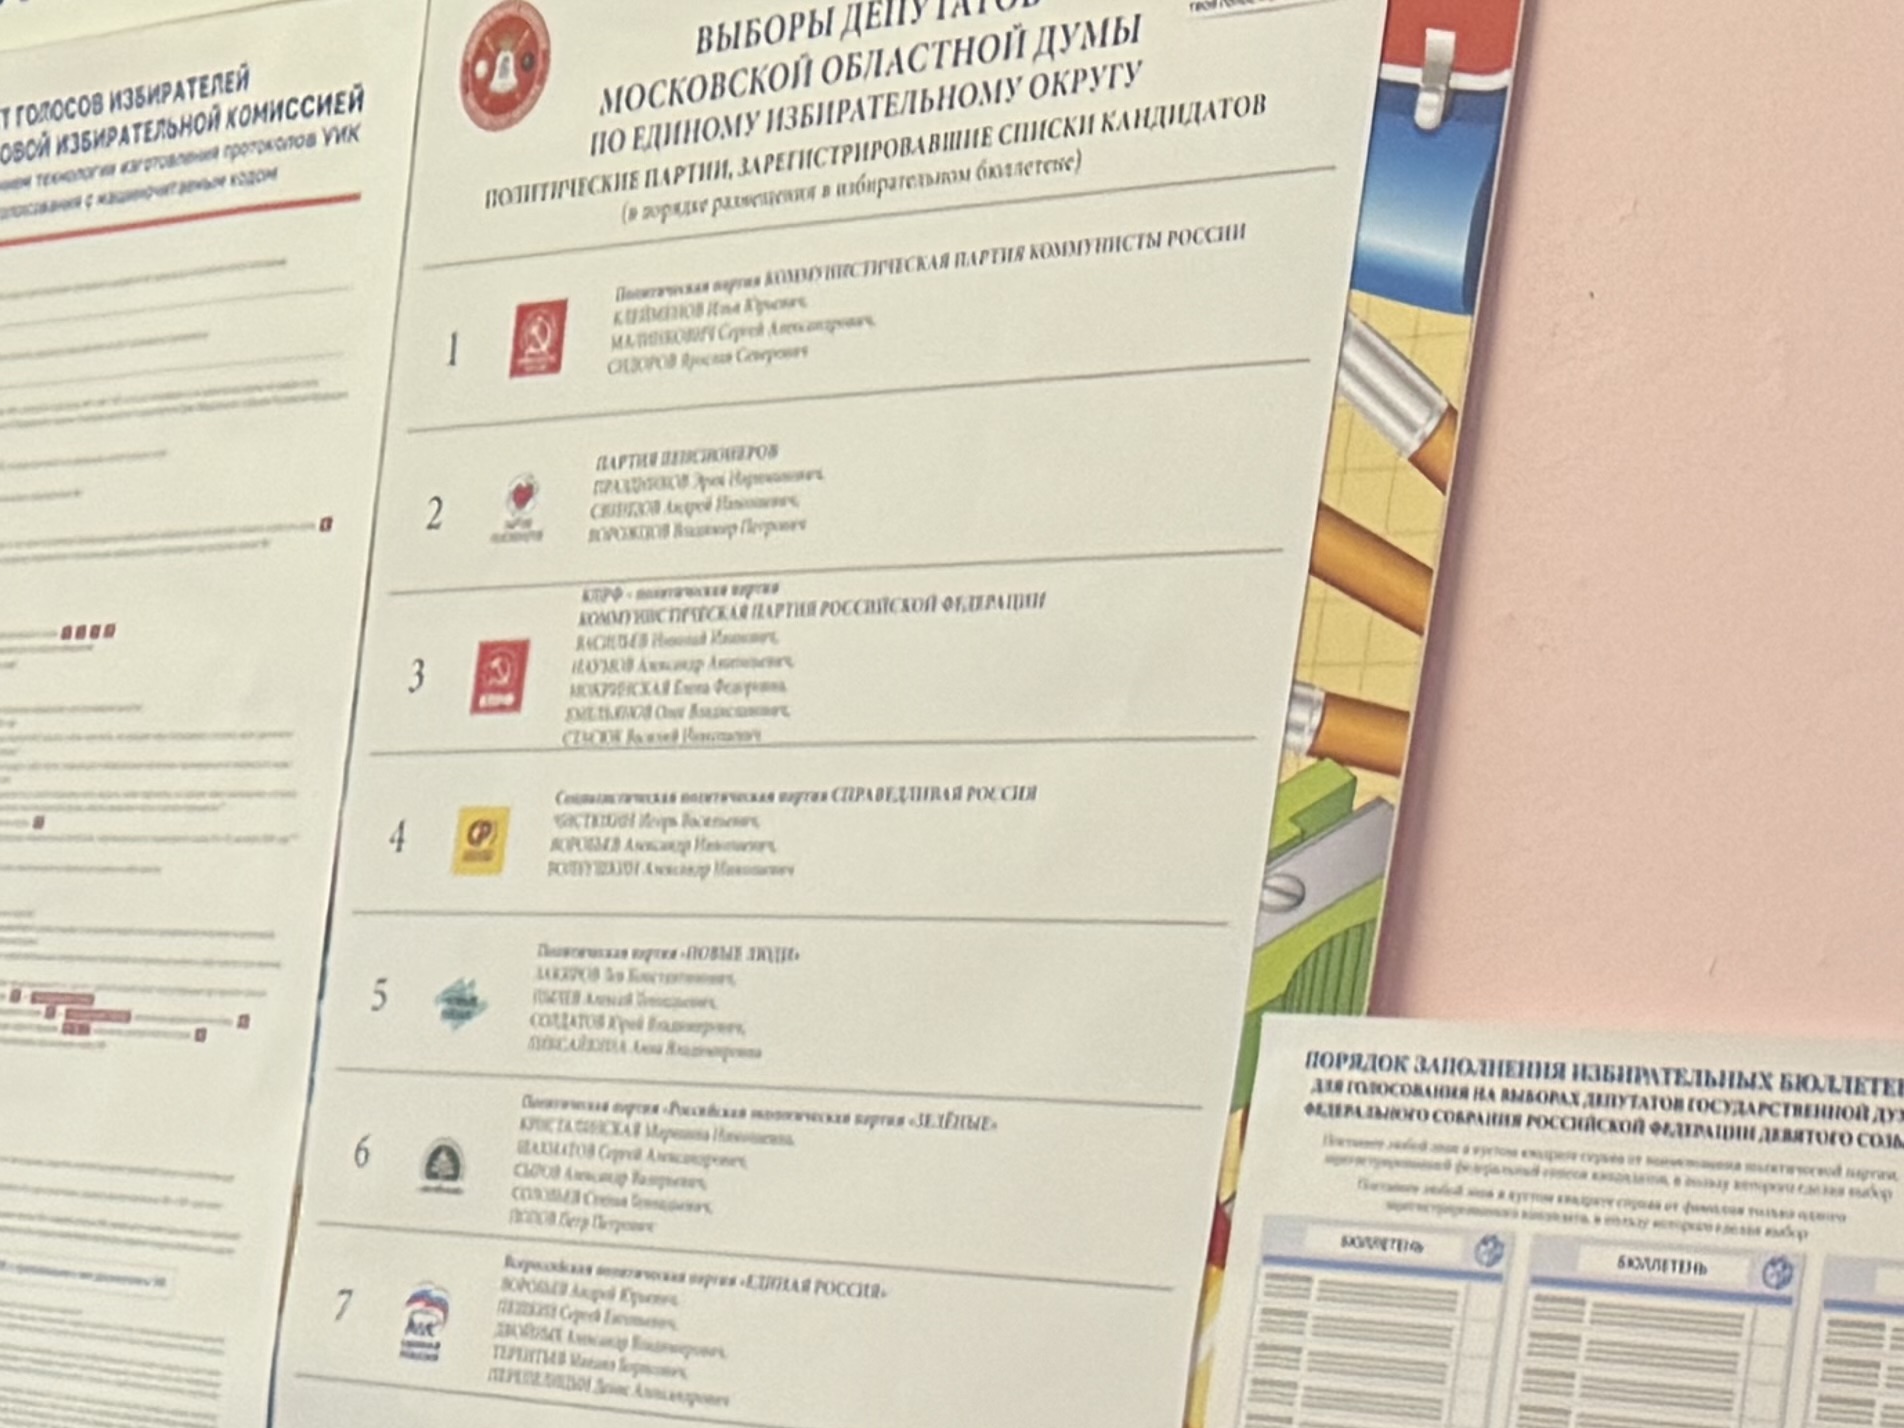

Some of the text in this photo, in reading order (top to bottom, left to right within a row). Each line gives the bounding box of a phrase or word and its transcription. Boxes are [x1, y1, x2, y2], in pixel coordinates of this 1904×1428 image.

[696, 6, 835, 55] ВЫБОРЫ
[599, 14, 1142, 117] МОСКОВСКОЙ ОБЛАСТНОЙ ДУМЫ
[15, 91, 104, 129] ГОЛОСОВ
[109, 66, 251, 112] ИЗБИРАТЕЛЕЙ
[589, 59, 1144, 156] ПО ЕДИНОМУ ИЗБИРАТЕЛЬНОМУ ОКРУГУ
[55, 107, 220, 156] ИЗБИРАТЕЛЬНОЙ
[225, 85, 365, 129] КОМИССИЕЙ
[223, 135, 317, 164] протоколов
[322, 124, 361, 146] УИК
[485, 93, 1267, 210] ПОЛИТИЧЕСКИЕ ПАРТИИ, ЗАРЕГИСТРИРОВАВШИЕ СПИСКИ КАНДИДАТОВ
[954, 246, 1026, 270] ПАРТИЯ
[1029, 230, 1163, 261] КОММУНИСТЫ
[1167, 222, 1247, 248] РОССИИ
[445, 330, 461, 369] 1
[425, 495, 444, 531] 2
[407, 657, 426, 695] 3
[388, 819, 407, 854] 4
[371, 978, 389, 1013] 5
[1305, 1050, 1410, 1074] ПОРЯДОК
[1413, 1055, 1566, 1081] ЗАПОЛНЕНИЯ
[1572, 1062, 1773, 1092] ИЗБИРАТЕЛЬНЫХ
[1310, 1077, 1870, 1121] ДЛЯ ГОЛОСОВАНИЯ НА ВЫБОРАХ ДЕПУТАТОВ ГОСУДАРСТВЕННОЙ
[1304, 1104, 1854, 1148] ФЕДЕРАЛЬНОГО СОБРАНИЯ РОССИЙСКОЙ ФЕДЕРАЦИИ ДЕВЯТОГО
[353, 1135, 371, 1169] 6
[1617, 1253, 1708, 1278] БЮЛЛЕТЕНЬ
[335, 1288, 354, 1322] 7
